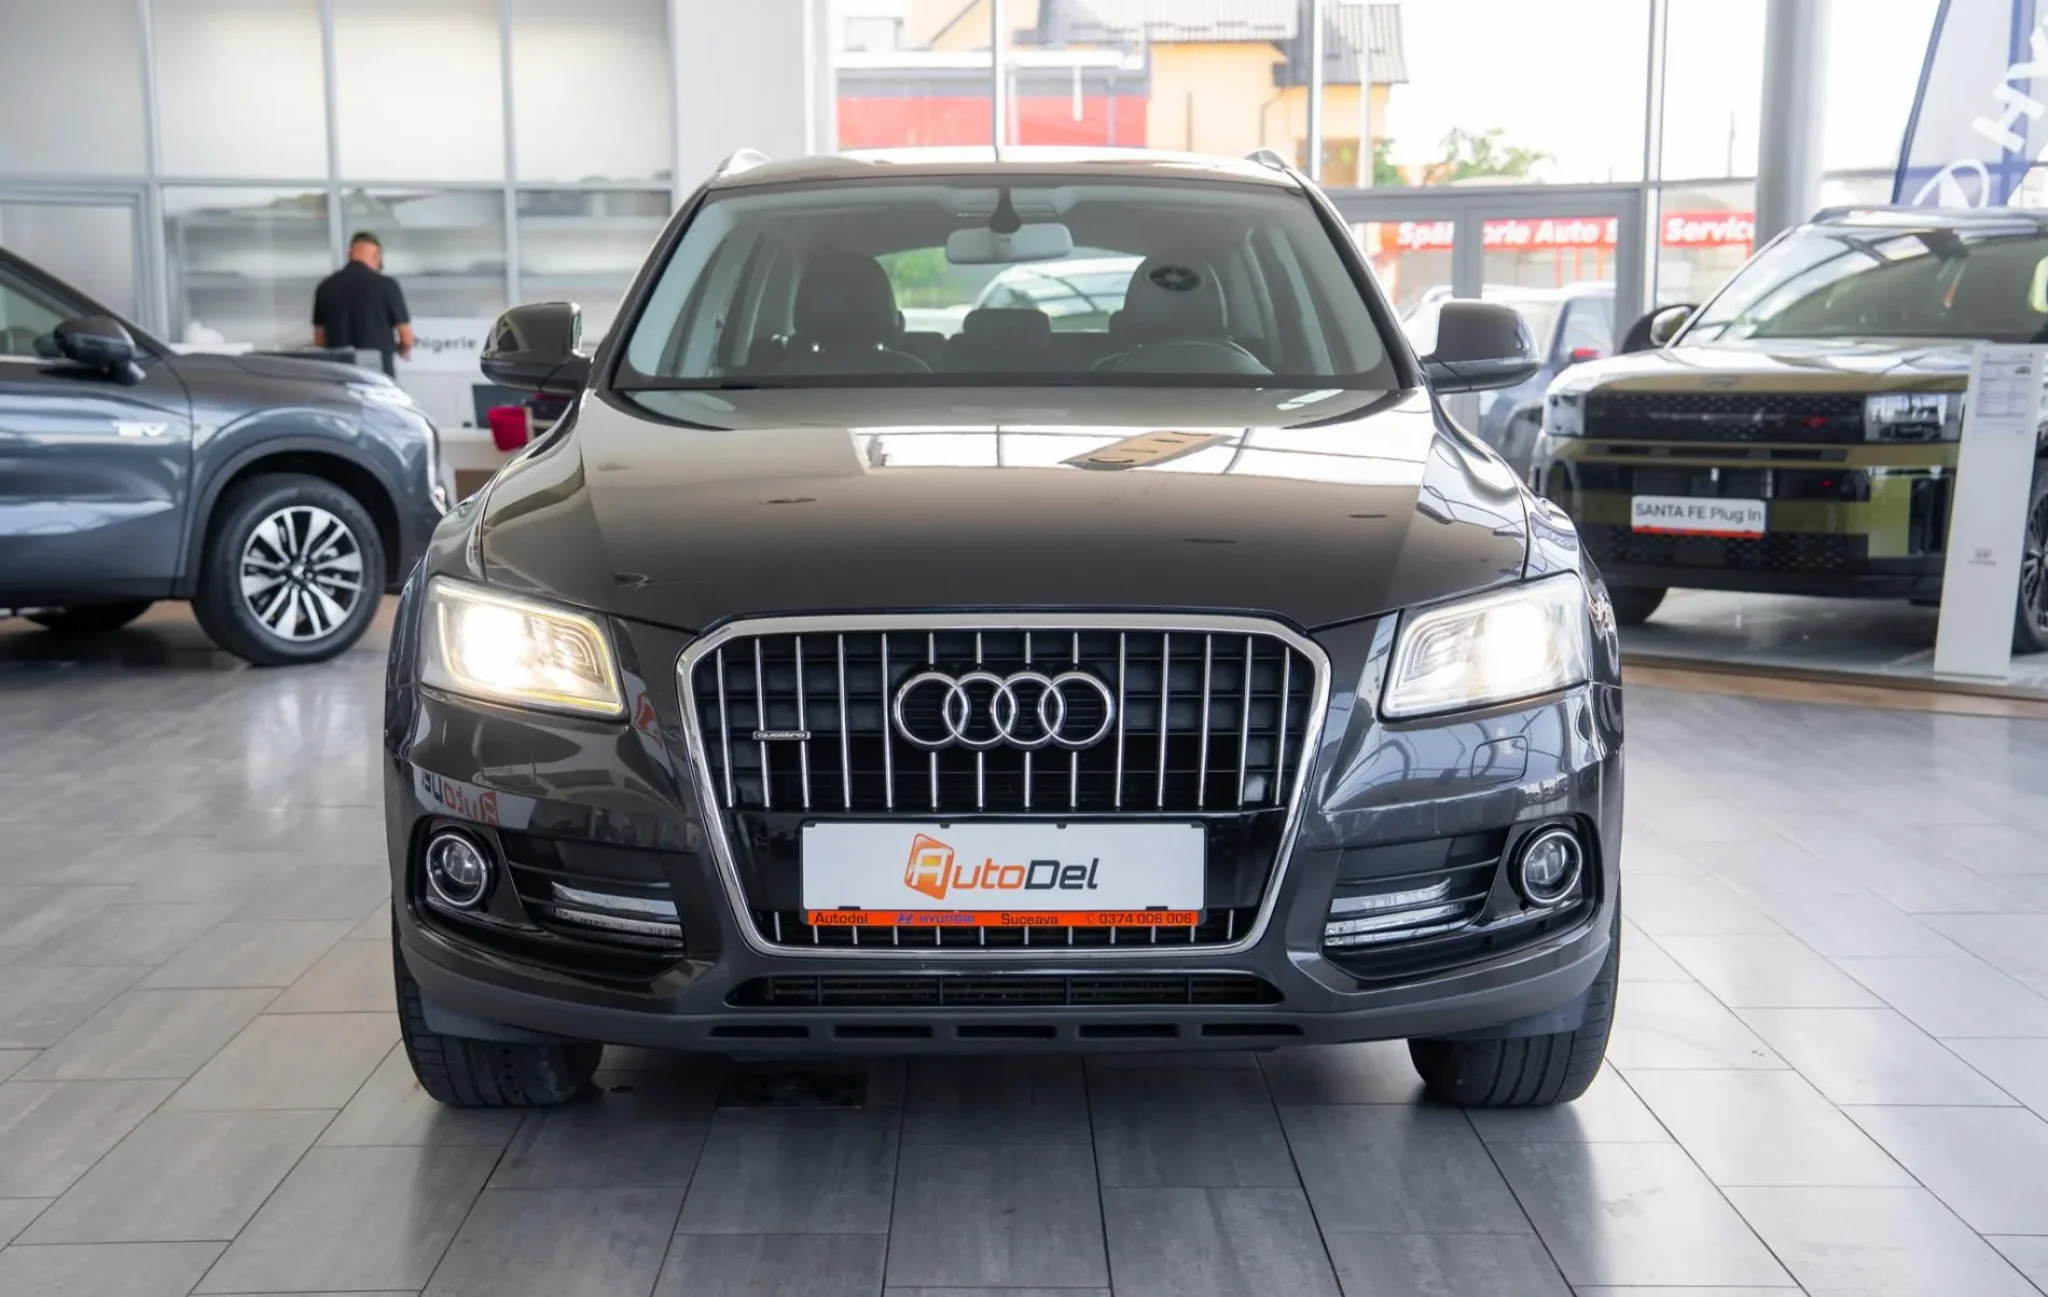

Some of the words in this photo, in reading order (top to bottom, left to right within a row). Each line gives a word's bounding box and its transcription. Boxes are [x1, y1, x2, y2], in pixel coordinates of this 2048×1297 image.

[1534, 219, 1599, 244] Auto
[1635, 502, 1683, 519] SANTA
[1688, 506, 1706, 520] FE
[1710, 506, 1743, 524] Plug
[1748, 507, 1762, 522] In
[757, 731, 806, 740] quattro
[910, 846, 1100, 890] AutoDel
[814, 912, 869, 925] Autodel
[918, 914, 975, 924] HYUNDAI
[1000, 913, 1059, 925] Suceava
[1099, 912, 1133, 925] 0374
[1137, 912, 1163, 925] 006
[1166, 912, 1193, 925] 006
